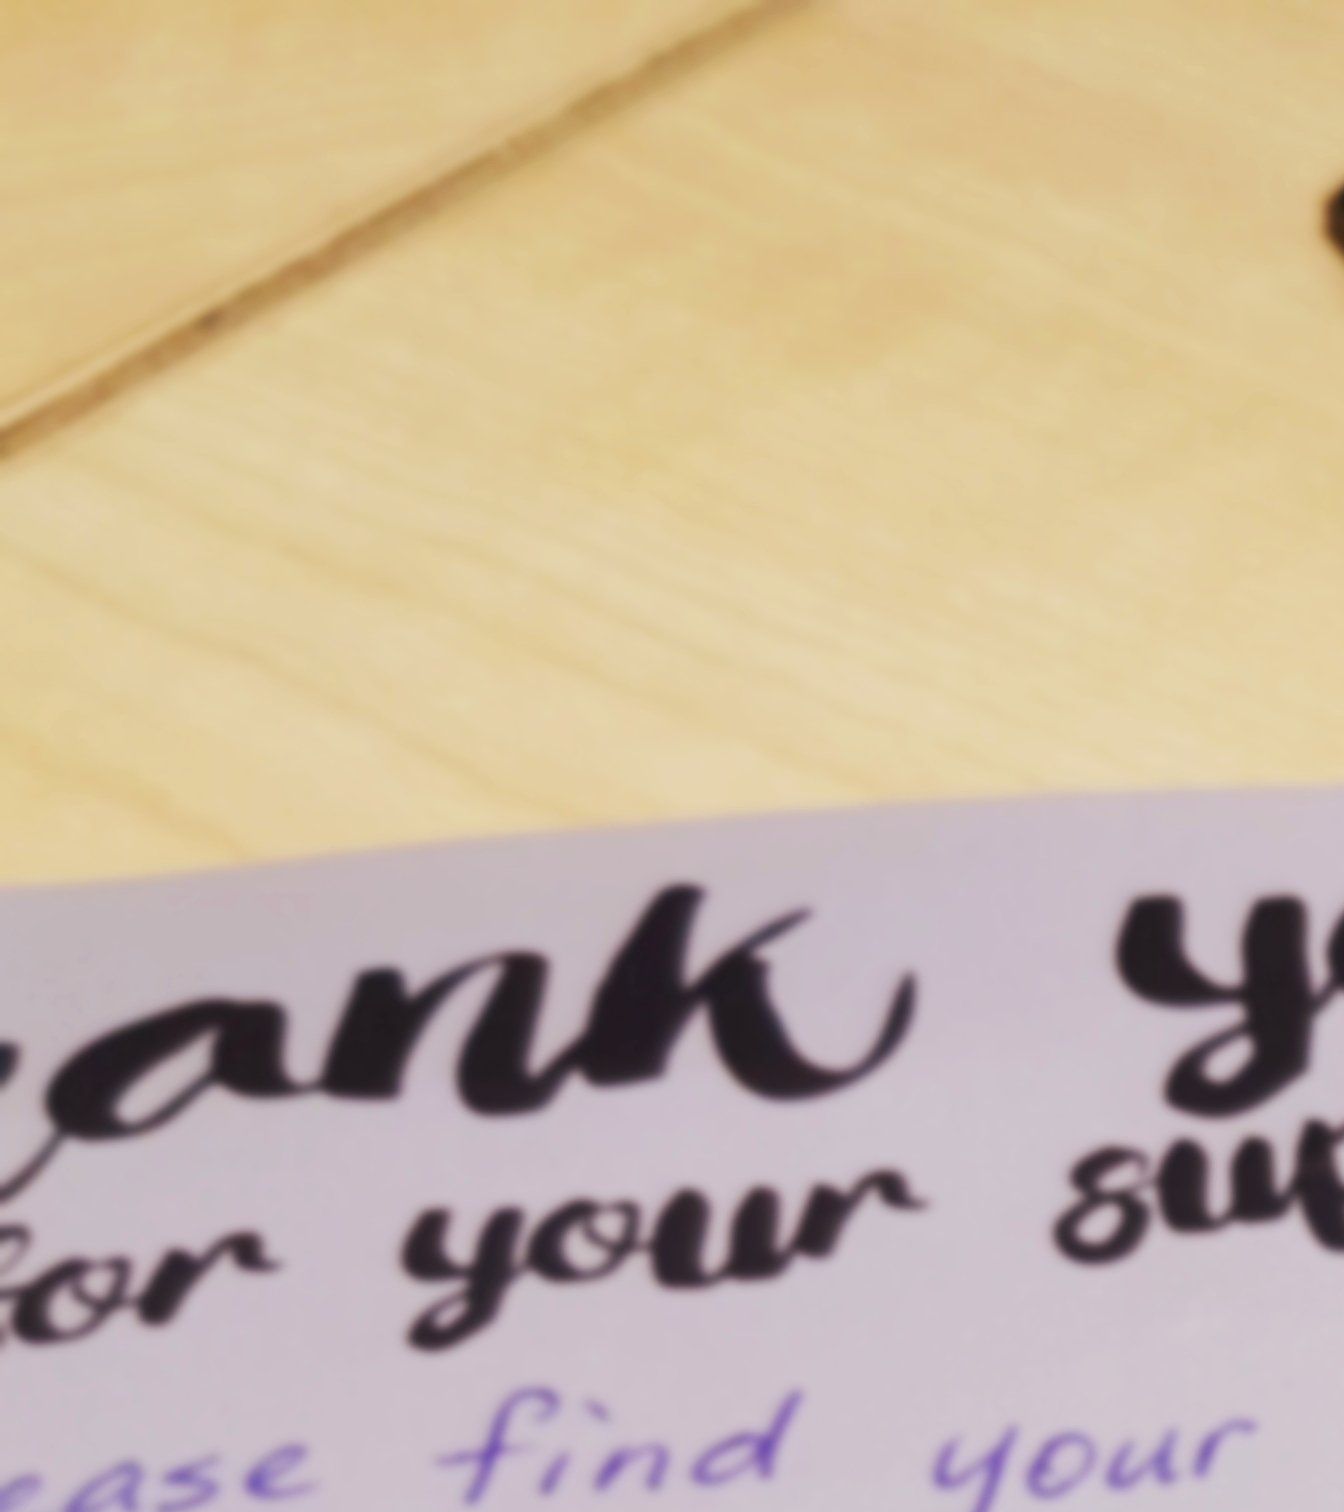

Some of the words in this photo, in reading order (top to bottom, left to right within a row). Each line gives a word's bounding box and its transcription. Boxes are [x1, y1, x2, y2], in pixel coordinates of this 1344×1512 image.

[0, 882, 918, 1200] ank
[400, 1168, 928, 1352] your
[435, 1385, 802, 1505] find
